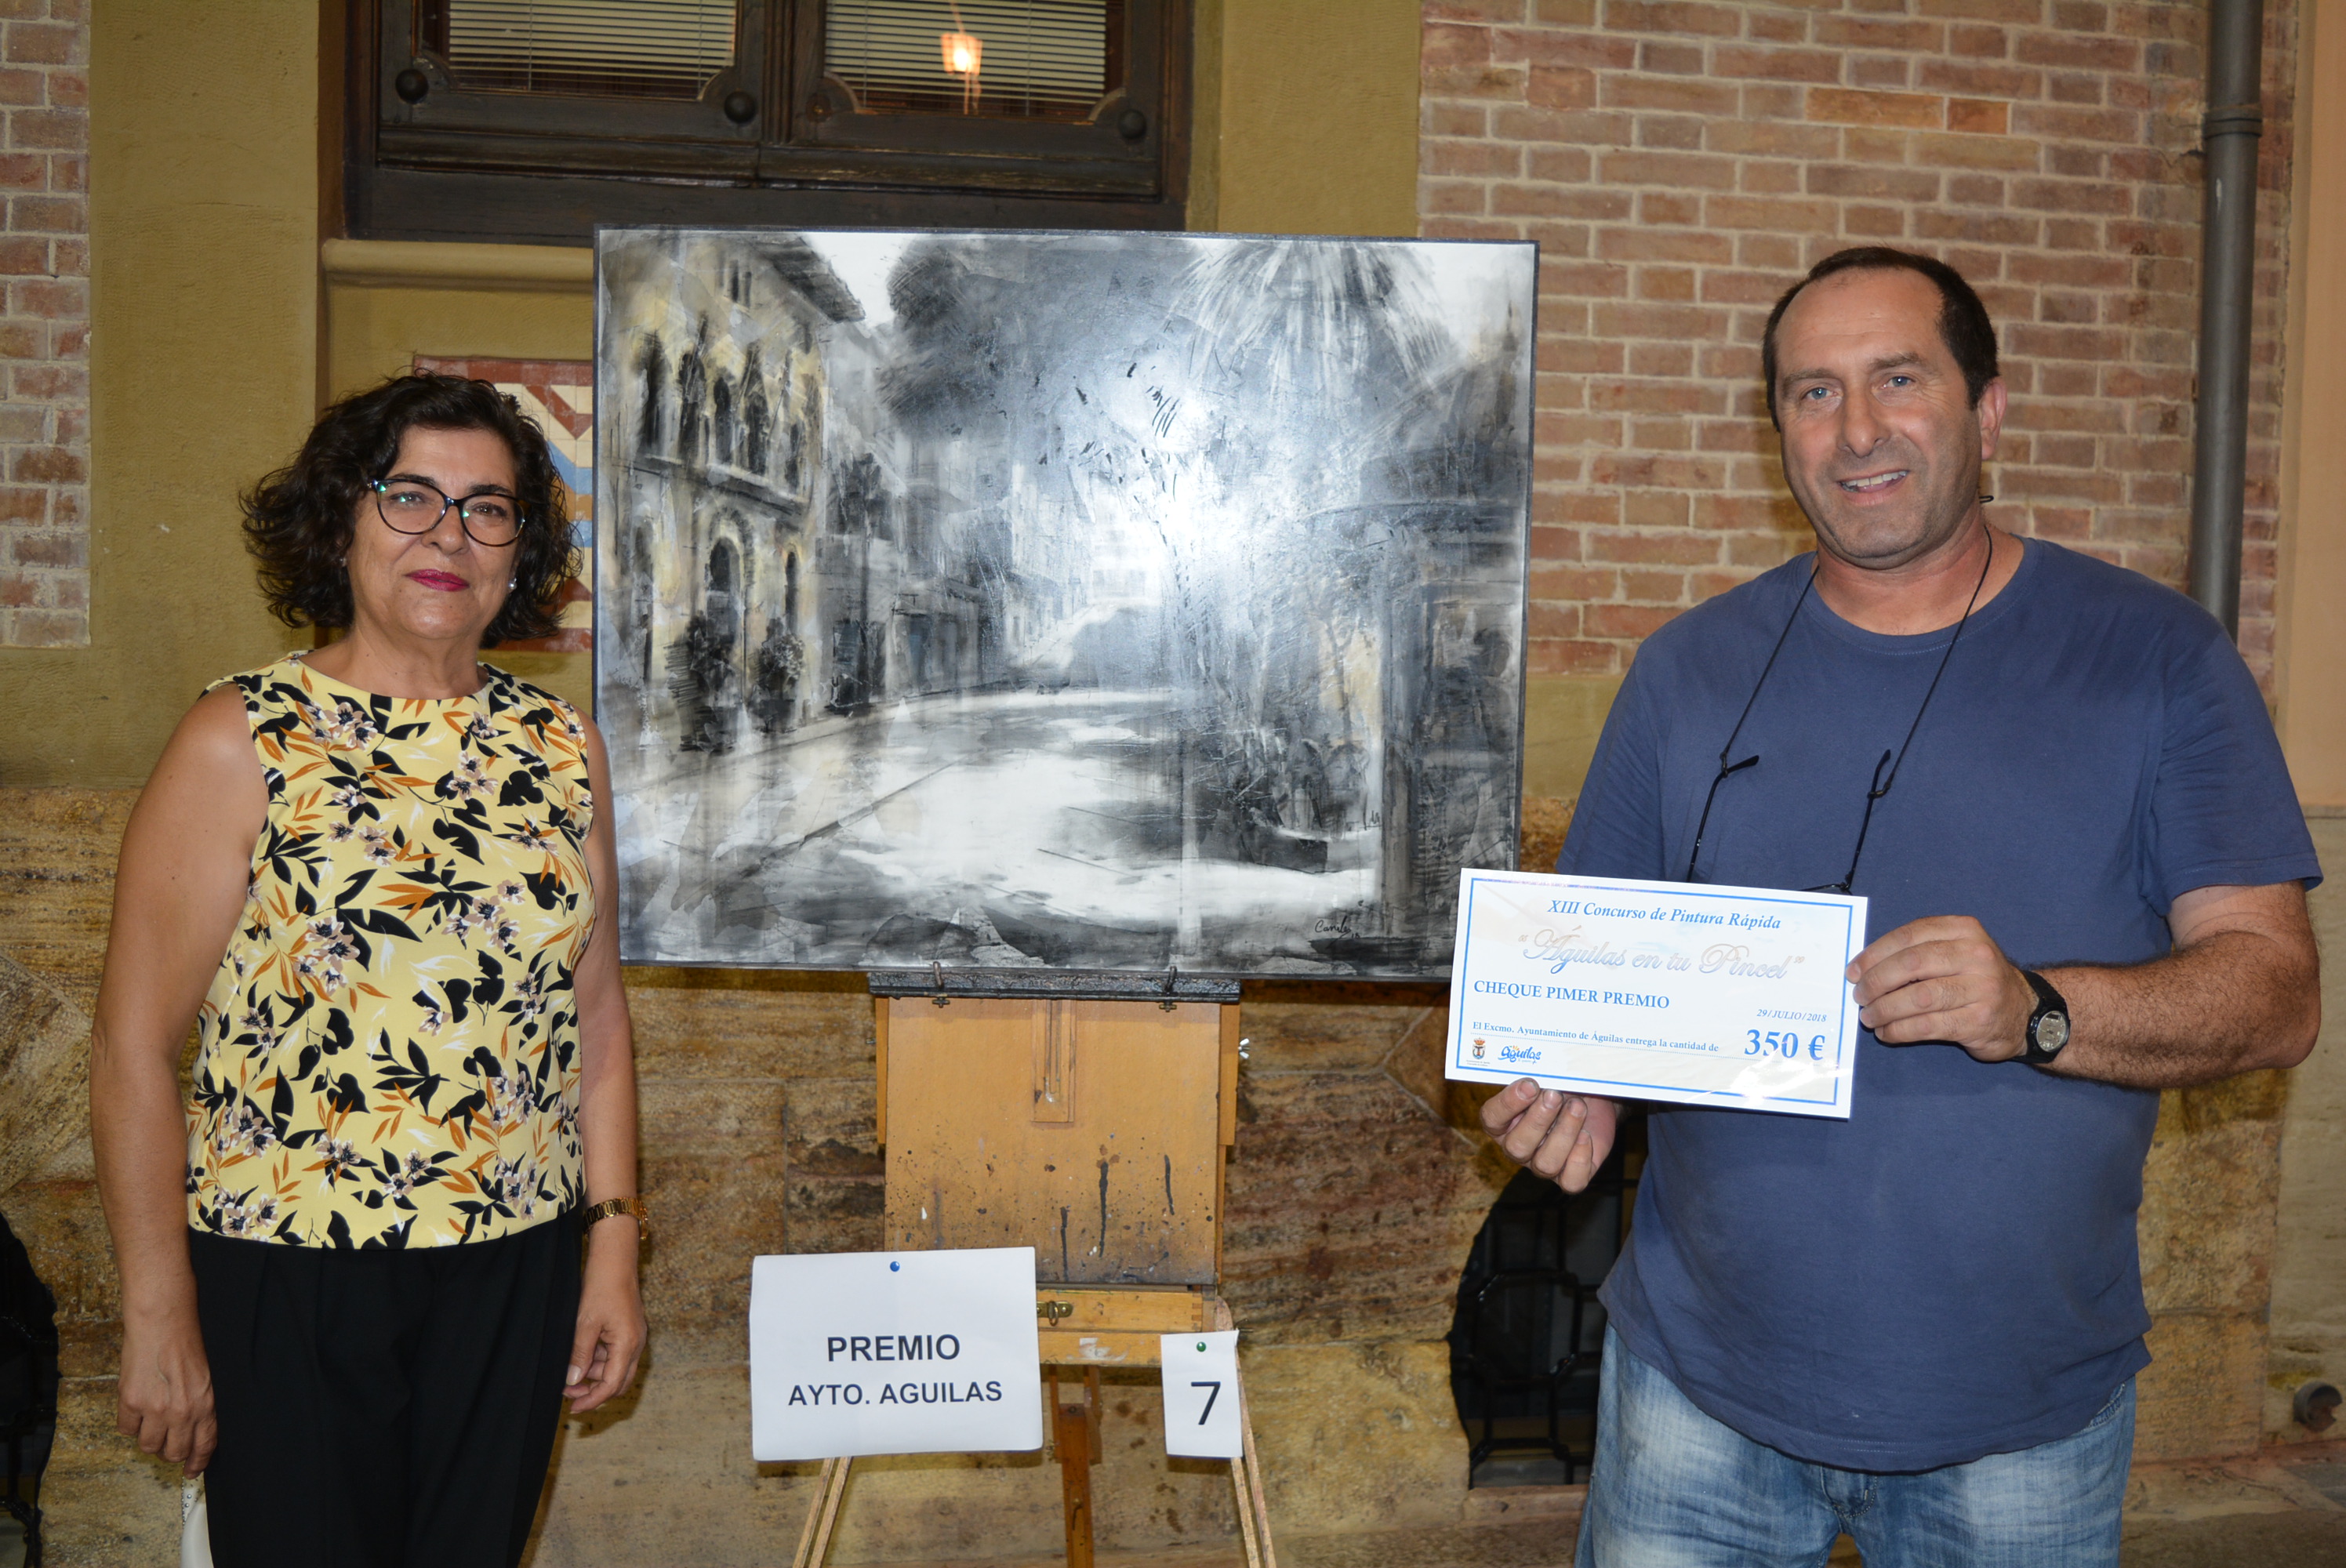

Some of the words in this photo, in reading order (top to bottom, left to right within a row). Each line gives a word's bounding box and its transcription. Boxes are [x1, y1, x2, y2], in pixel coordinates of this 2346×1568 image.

[1548, 900, 1579, 913] XIII
[1584, 903, 1646, 918] Concurso
[1651, 907, 1666, 920] de
[1671, 909, 1723, 924] Pintura
[1728, 913, 1781, 930] Rápida
[1632, 953, 1661, 969] en
[1666, 953, 1691, 971] tu
[1474, 981, 1542, 998] CHEQUE
[1547, 987, 1598, 1002] PIMER
[1603, 992, 1669, 1008] PREMIO
[1484, 1023, 1515, 1033] Excmo.
[1518, 1026, 1577, 1038] Ayuntamiento
[1592, 1031, 1623, 1044] Águilas
[1625, 1038, 1657, 1047] entrega
[1670, 1041, 1706, 1051] cantidad
[1744, 1029, 1799, 1058] 350
[1807, 1035, 1826, 1060] €
[828, 1334, 959, 1361] PREMIO
[789, 1385, 869, 1405] AYTO.
[880, 1381, 1001, 1403] AGUILAS
[1191, 1381, 1220, 1425] 7
